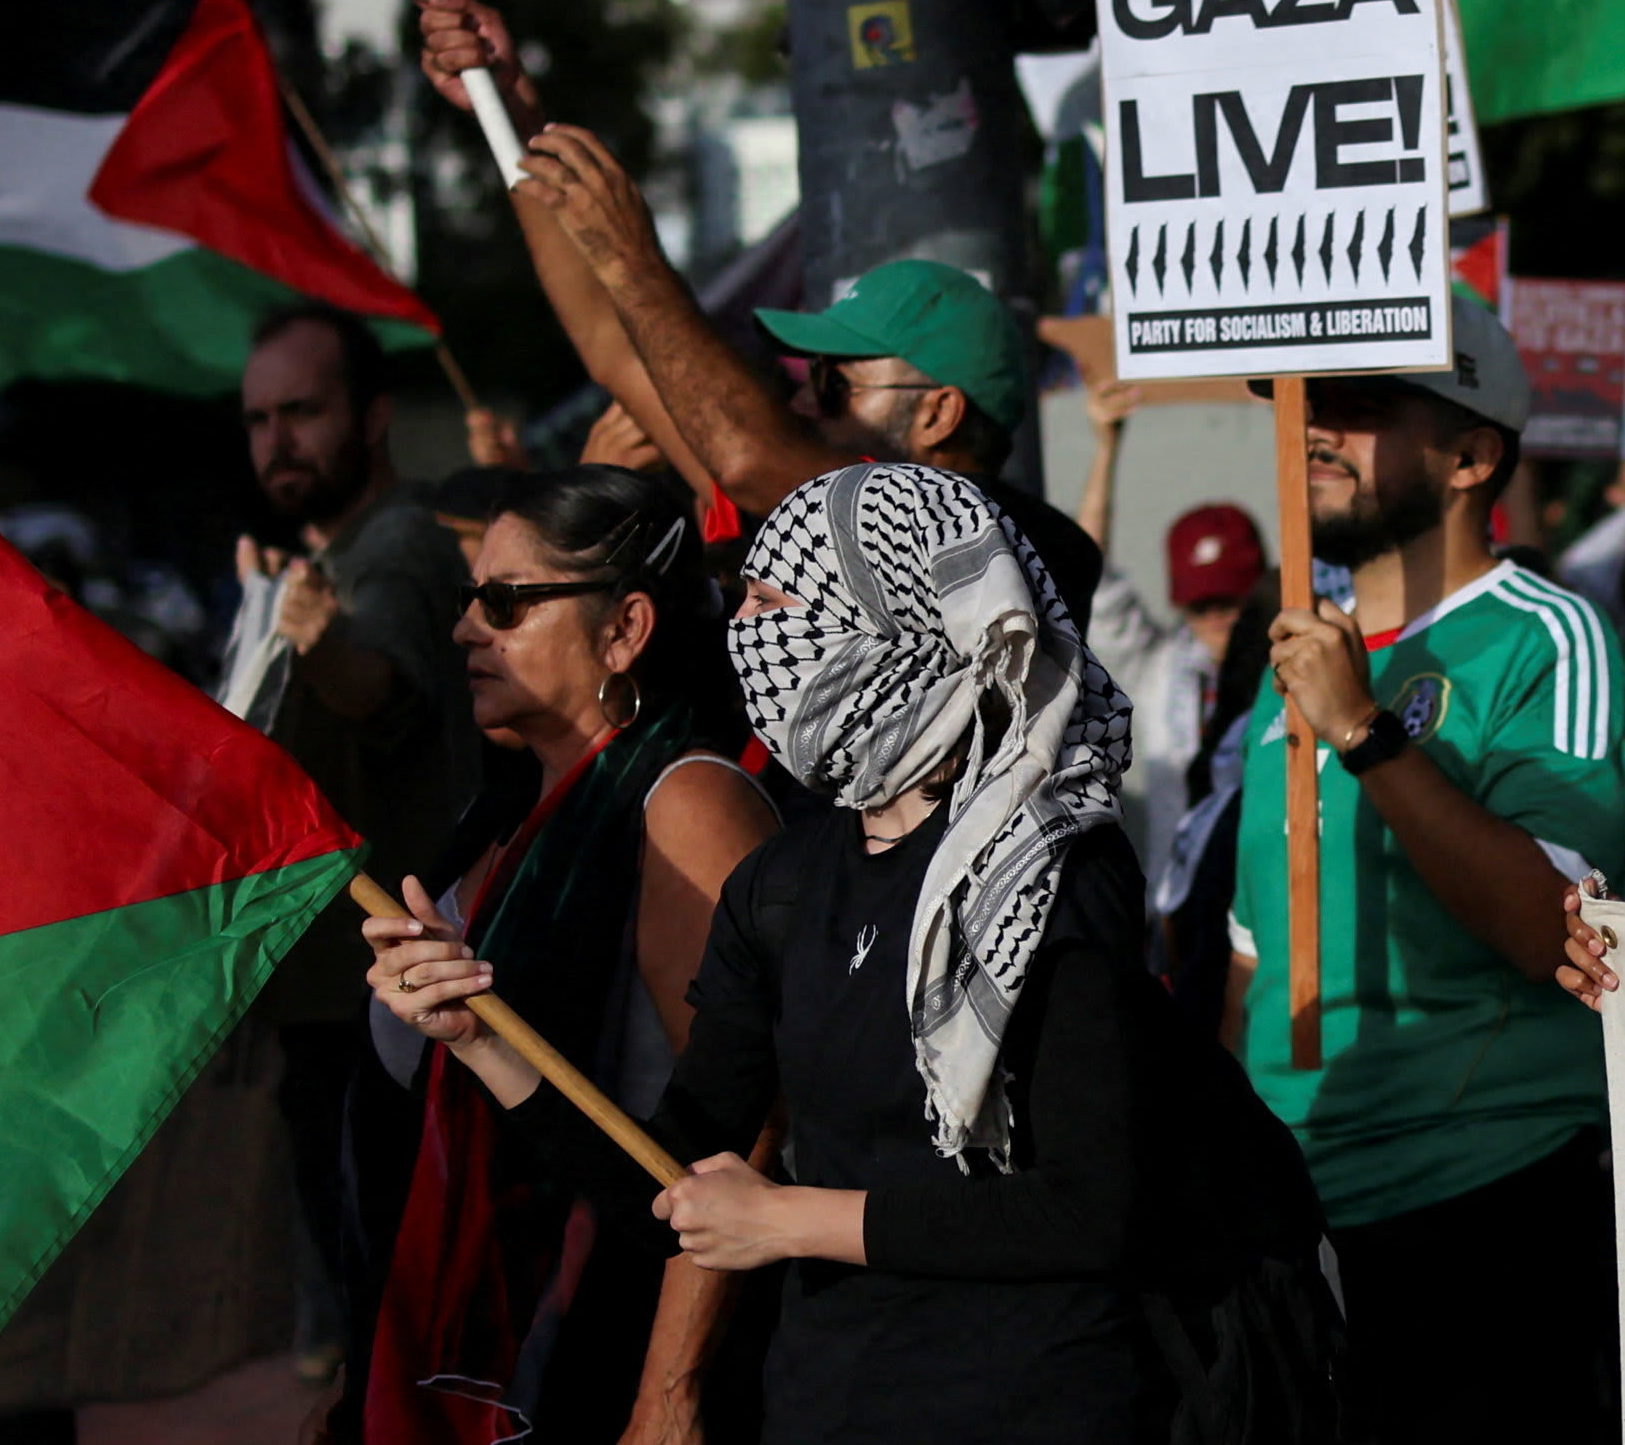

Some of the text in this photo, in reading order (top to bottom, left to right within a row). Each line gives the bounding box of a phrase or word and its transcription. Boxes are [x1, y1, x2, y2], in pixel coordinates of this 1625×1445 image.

[1119, 74, 1427, 203] LIVE!
[1131, 305, 1428, 346] PARTY FOR SOCIALISM & LIBERATION
